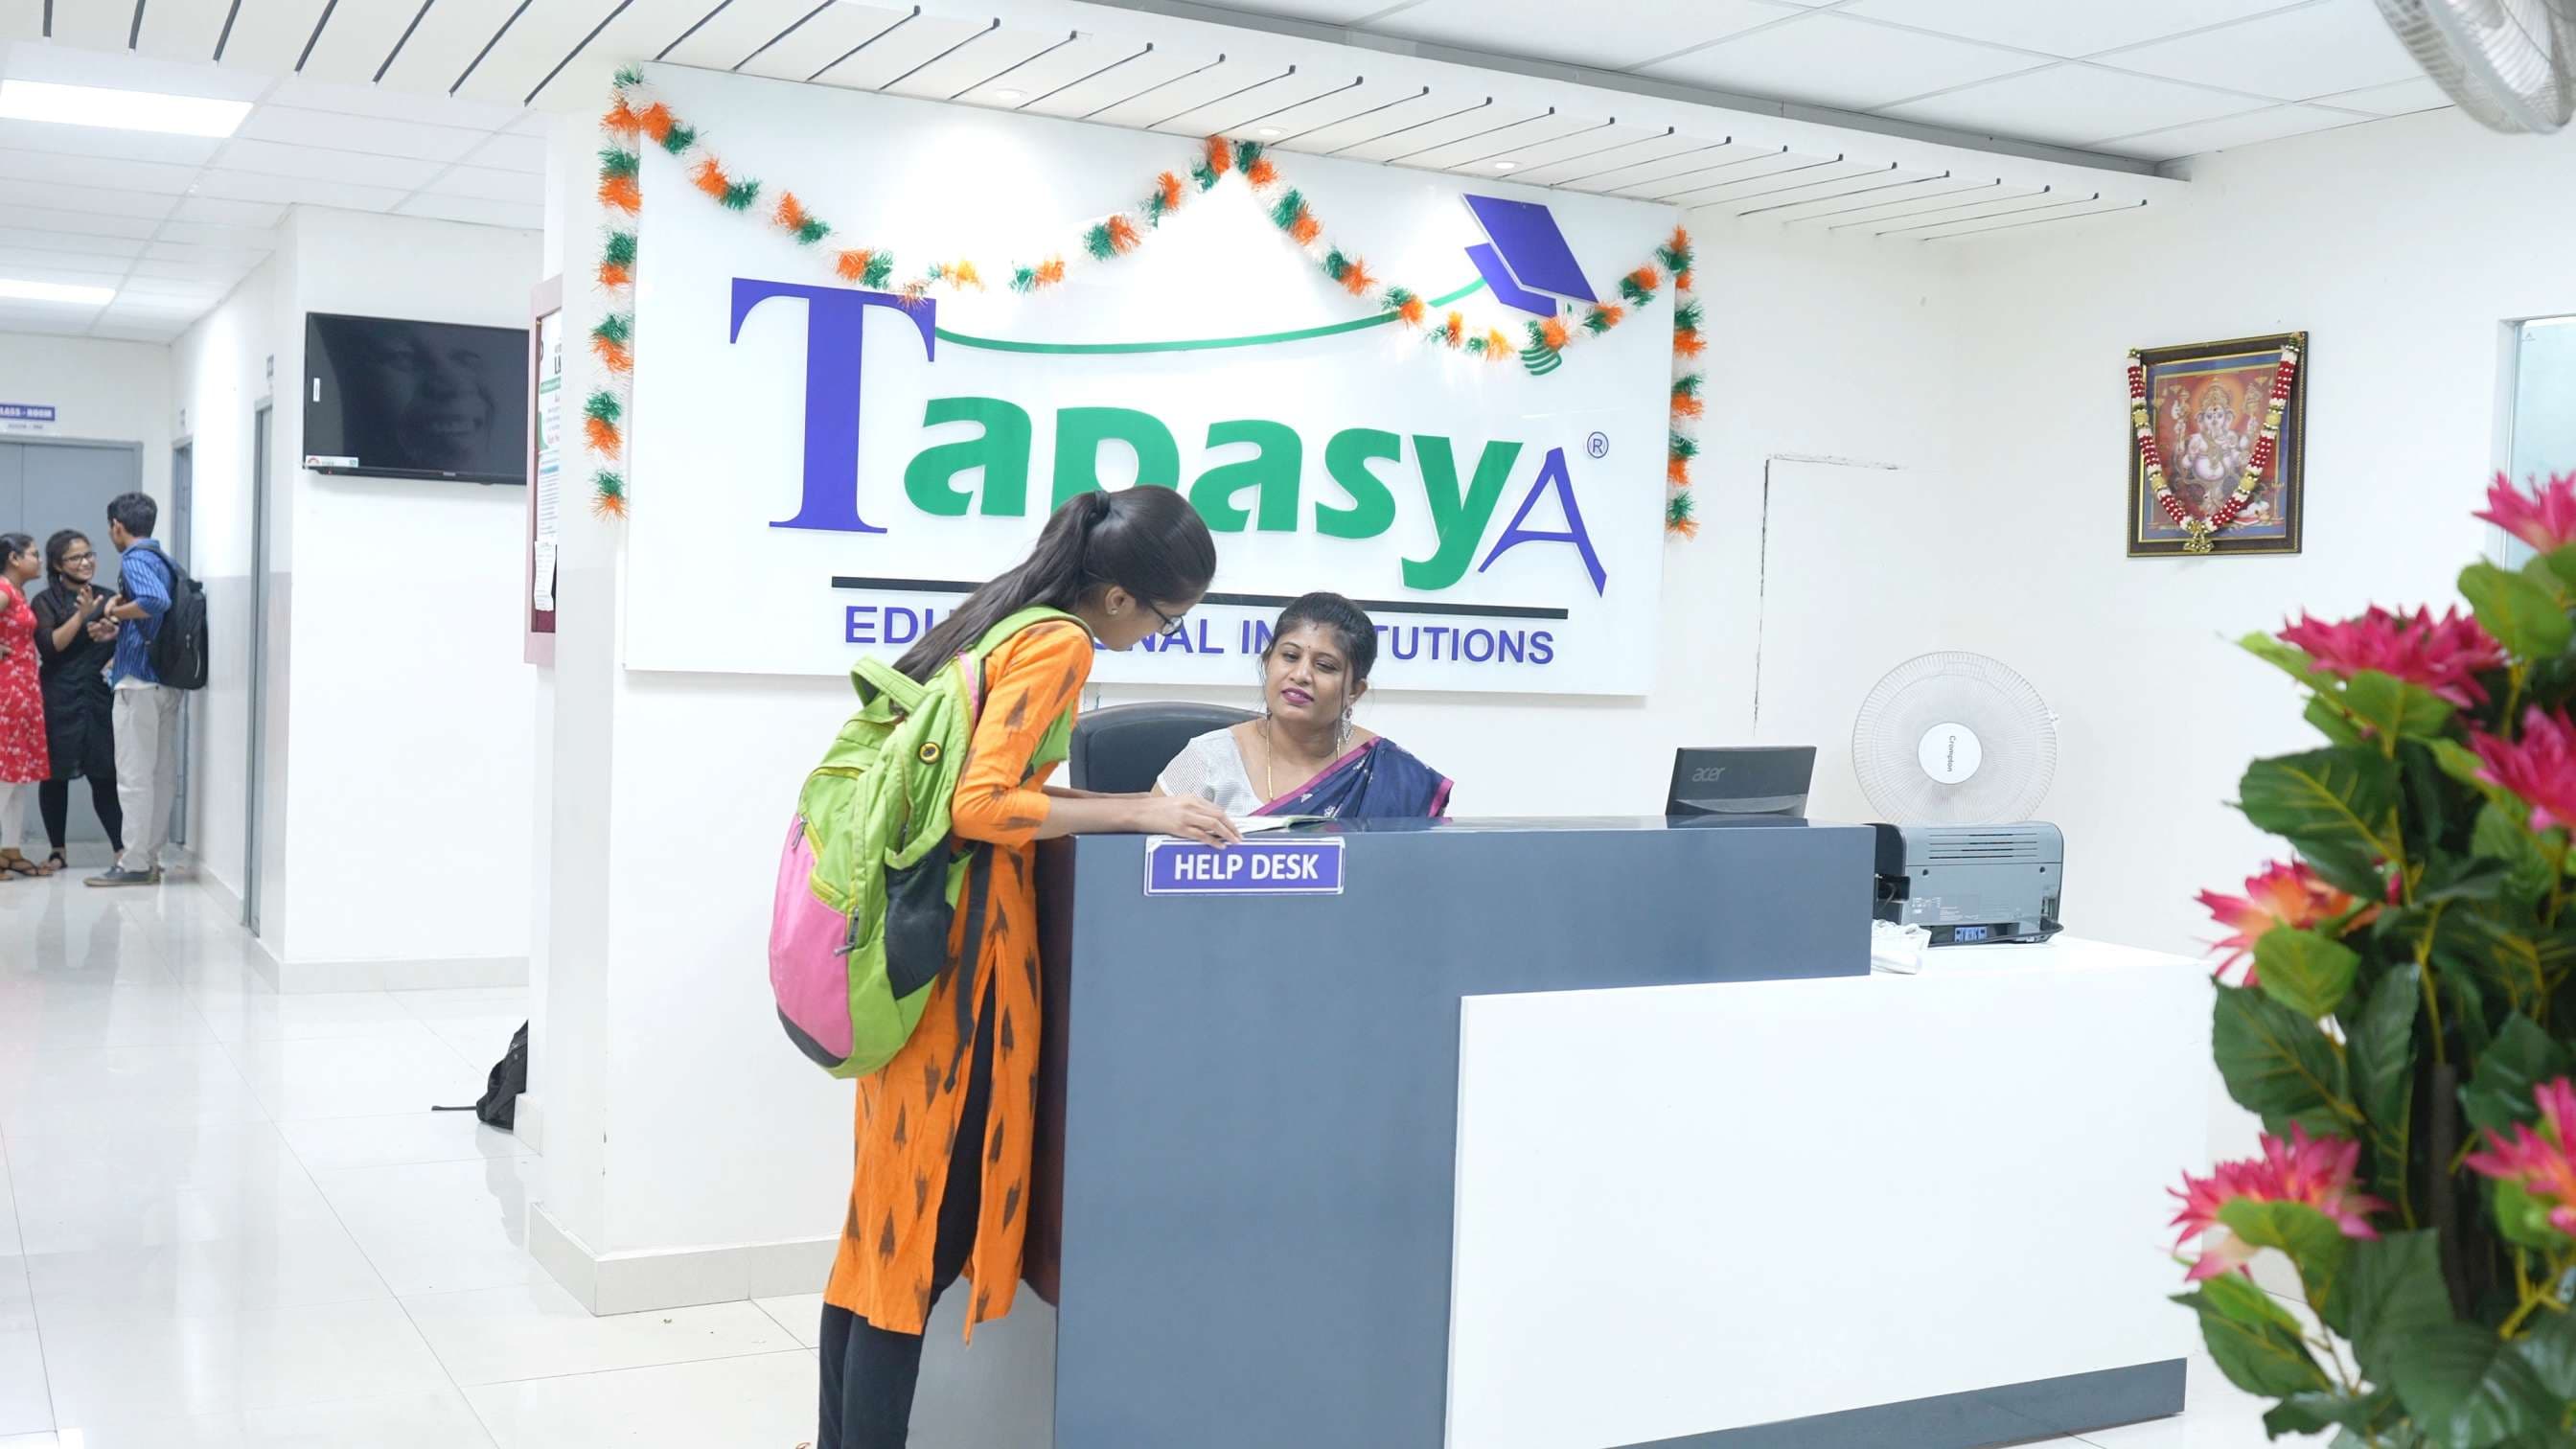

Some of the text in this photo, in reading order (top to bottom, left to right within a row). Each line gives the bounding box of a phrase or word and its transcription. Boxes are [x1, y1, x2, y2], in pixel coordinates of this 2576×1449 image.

[0, 406, 20, 418] LASS
[1946, 735, 1957, 772] Crompton
[1692, 767, 1726, 782] acer
[1175, 854, 1320, 881] HELP DESK
